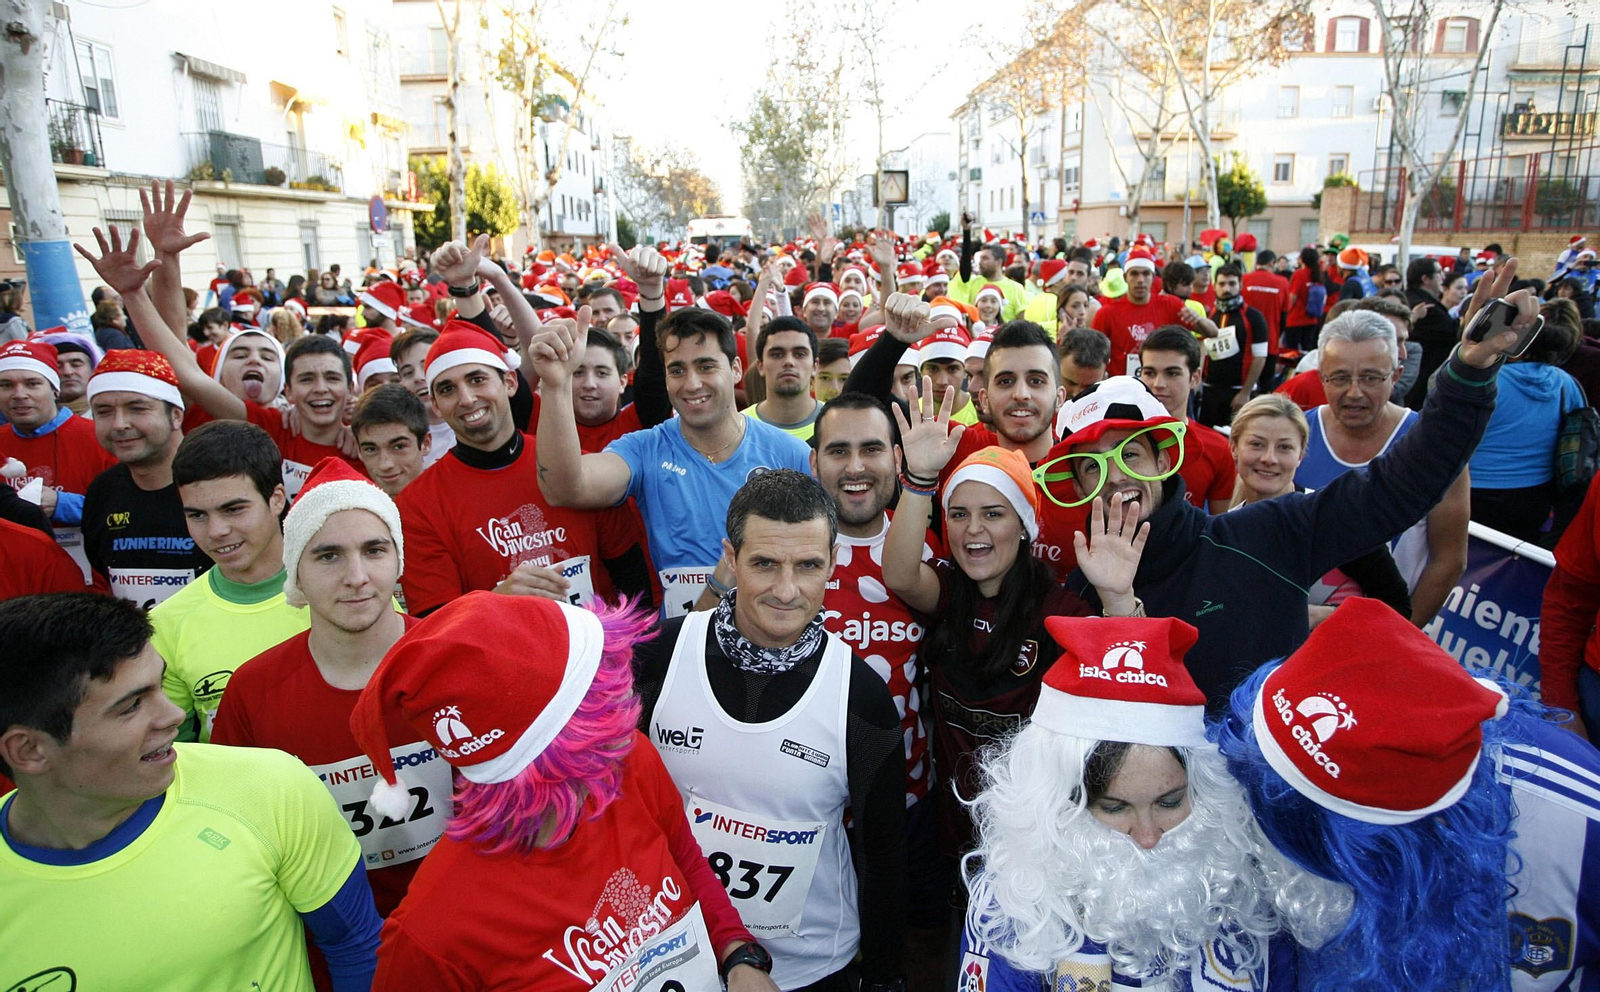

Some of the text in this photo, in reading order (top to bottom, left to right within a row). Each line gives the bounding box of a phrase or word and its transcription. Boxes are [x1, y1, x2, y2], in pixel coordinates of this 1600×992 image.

[118, 575, 190, 586] INTERSPORT
[823, 611, 925, 649] Cajaso
[1079, 663, 1168, 688] isla chica
[459, 729, 505, 755] chica
[1272, 688, 1340, 778] isla chica
[712, 814, 818, 845] INTERSPORT
[708, 851, 795, 903] 837
